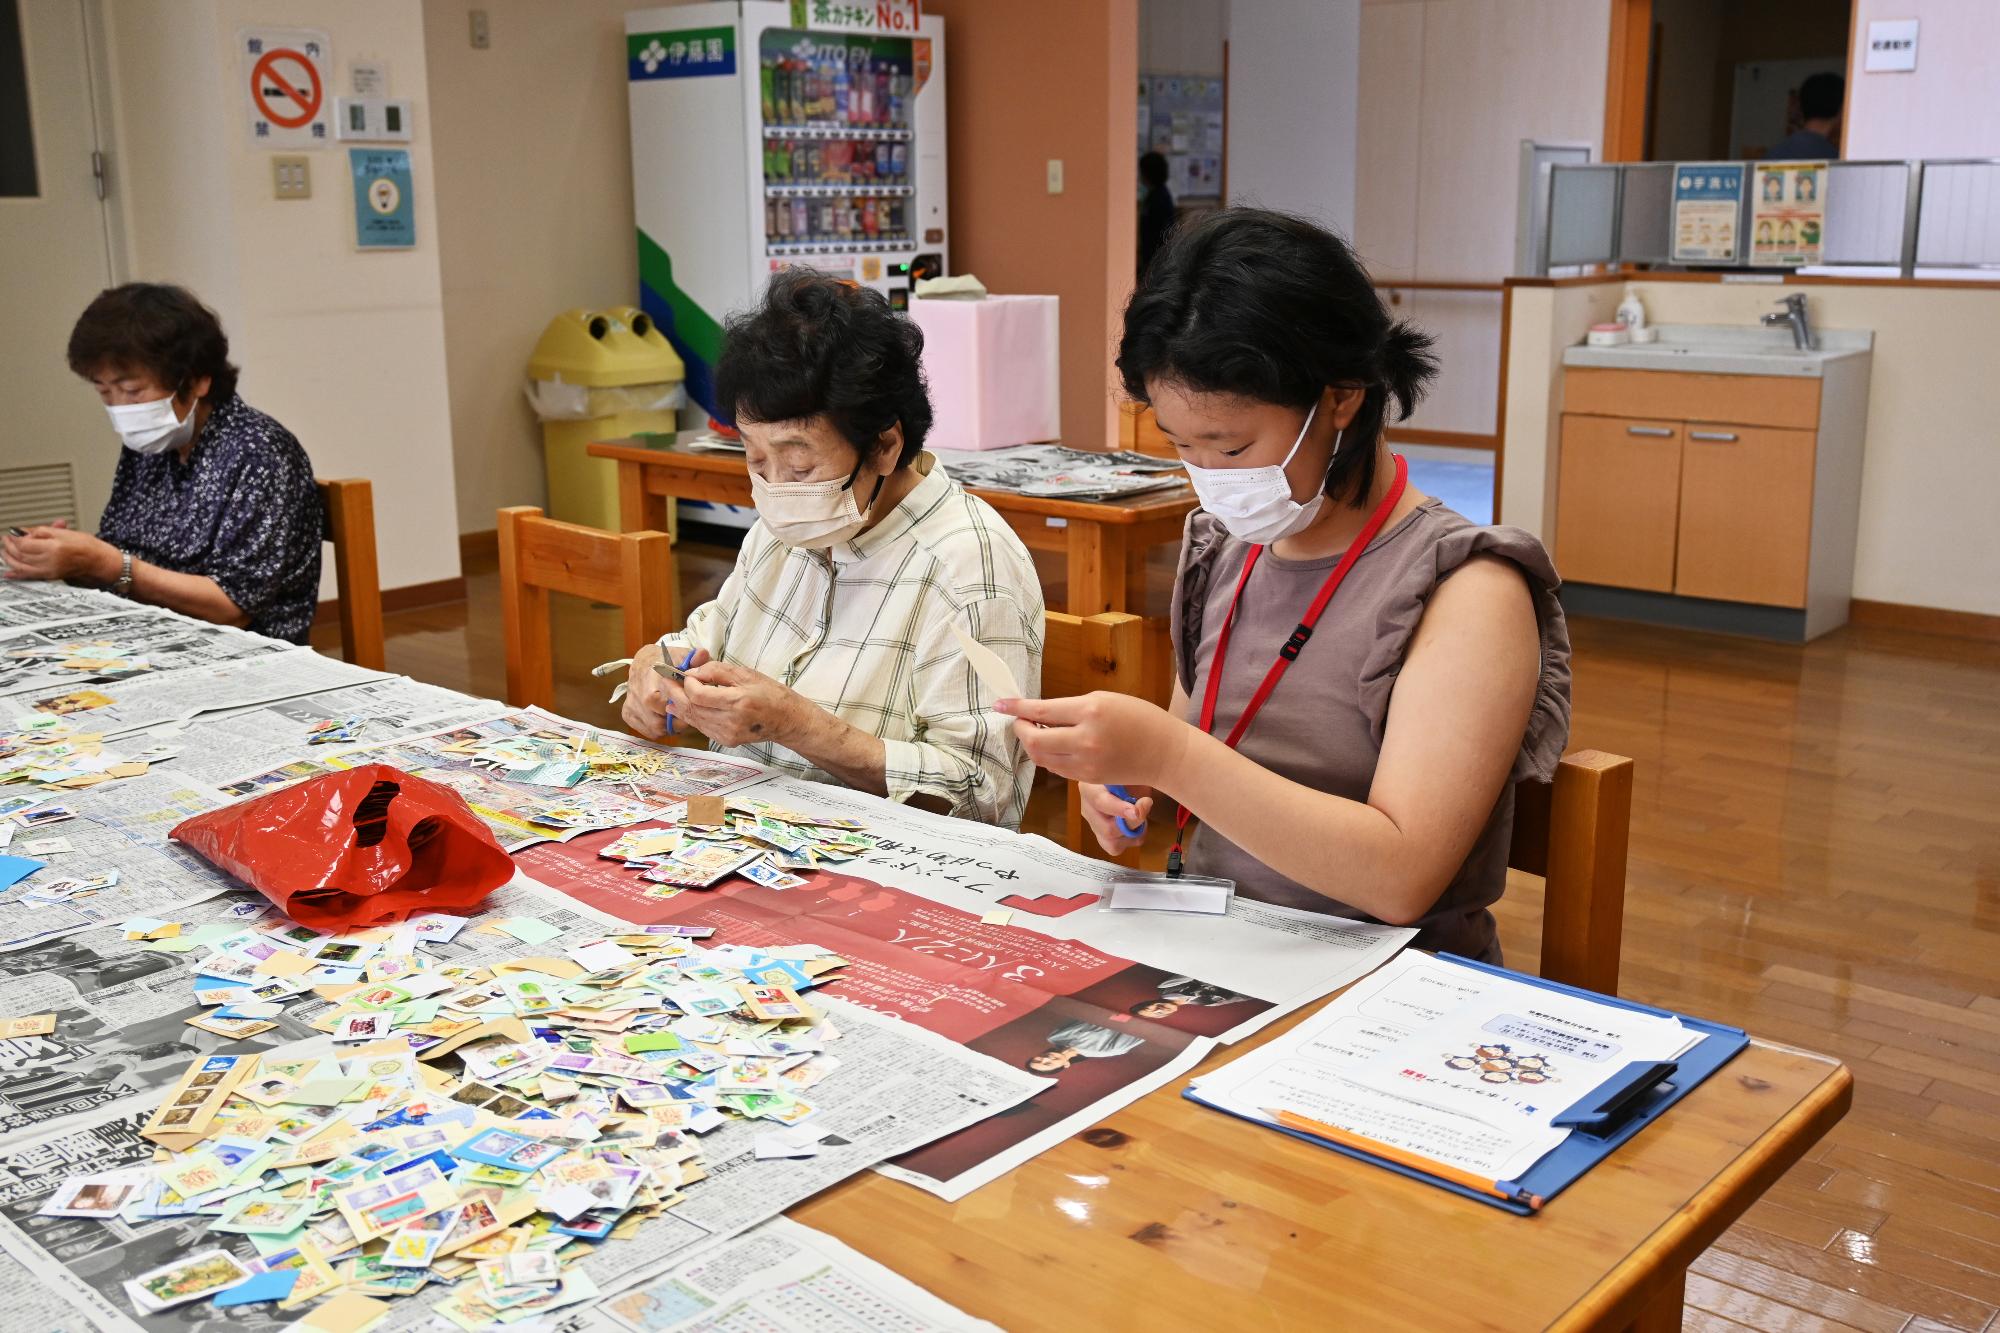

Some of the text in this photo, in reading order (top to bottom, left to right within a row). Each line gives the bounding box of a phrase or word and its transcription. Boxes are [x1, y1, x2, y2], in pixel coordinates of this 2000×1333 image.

[814, 0, 875, 26] 茶カテキン
[305, 42, 321, 57] 内
[669, 38, 724, 64] 伊藤園
[814, 44, 873, 63] ITO EN
[255, 121, 327, 138] 禁 煙
[1693, 174, 1737, 190] 手洗い
[889, 928, 1044, 984] 3人に2人
[0, 1083, 138, 1133] 投手5回5K
